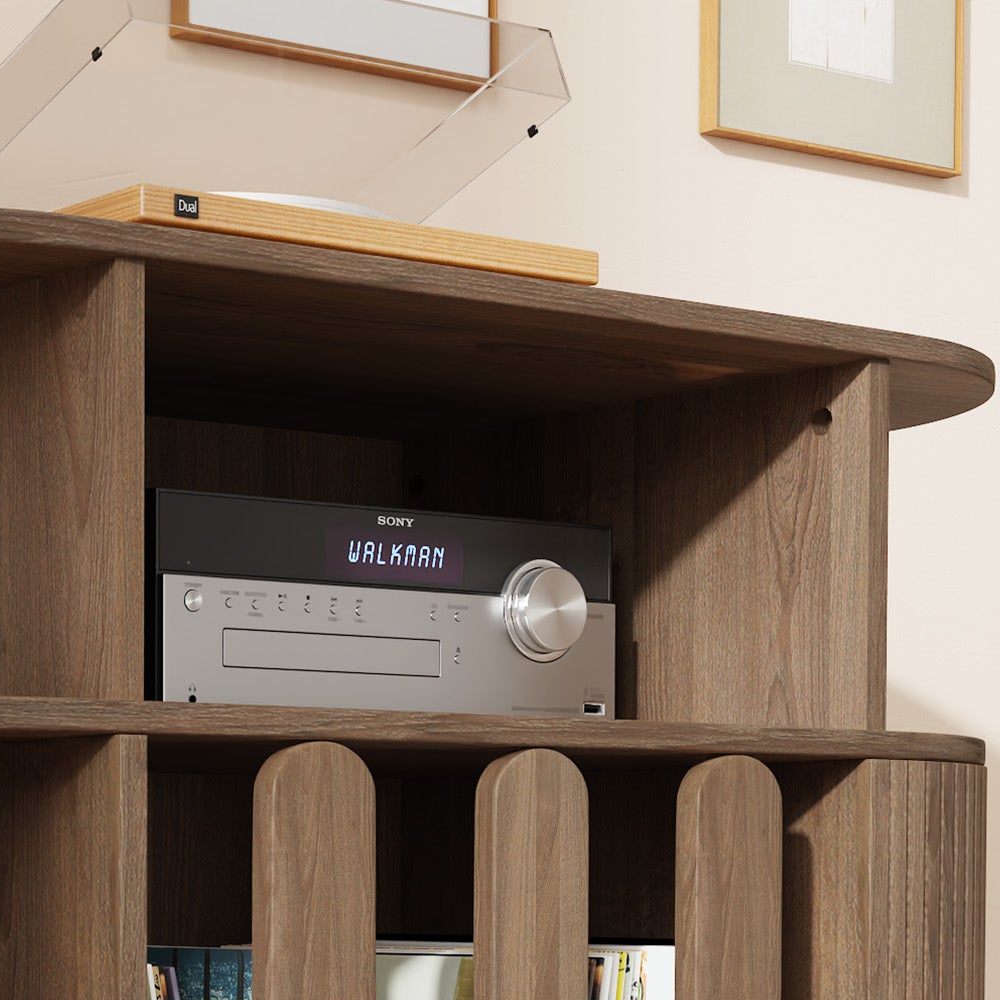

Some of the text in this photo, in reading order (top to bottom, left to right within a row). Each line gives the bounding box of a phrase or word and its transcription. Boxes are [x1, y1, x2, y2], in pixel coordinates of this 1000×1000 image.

[178, 199, 197, 213] Dual
[377, 515, 415, 528] SONY
[348, 540, 445, 569] WALKMAN
